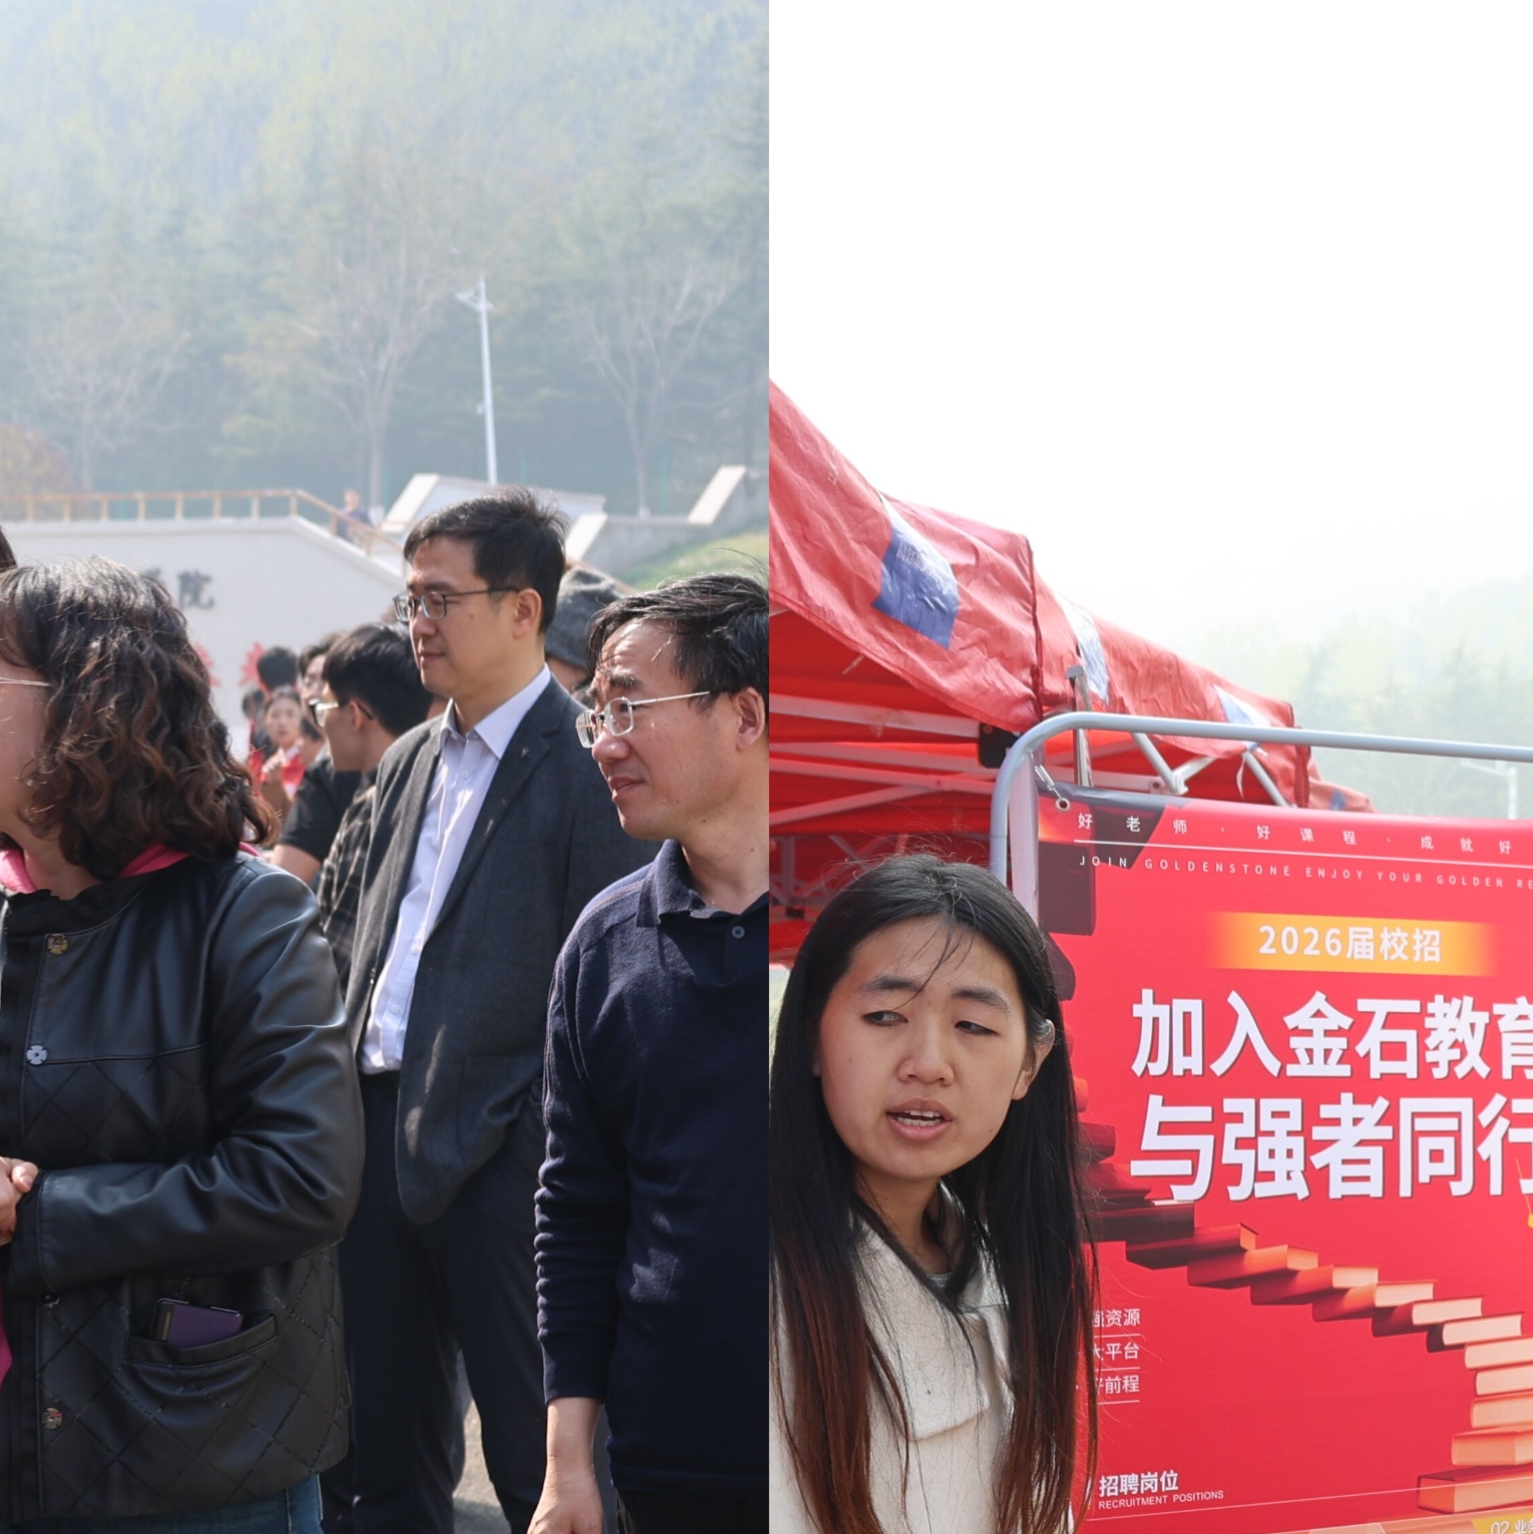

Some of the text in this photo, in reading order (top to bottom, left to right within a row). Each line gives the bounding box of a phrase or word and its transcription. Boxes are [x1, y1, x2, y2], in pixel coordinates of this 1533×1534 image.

[1079, 855, 1128, 868] JOIN
[1144, 858, 1291, 877] GOLDENSTONE
[1305, 866, 1364, 880] ENJOY
[1376, 870, 1424, 884] YOUR
[1436, 873, 1504, 888] GOLDEN
[1258, 924, 1442, 963] 2026届校招
[1098, 1469, 1179, 1498] 招聘岗位
[1098, 1490, 1225, 1510] RECRUITMENT POSITIONS
